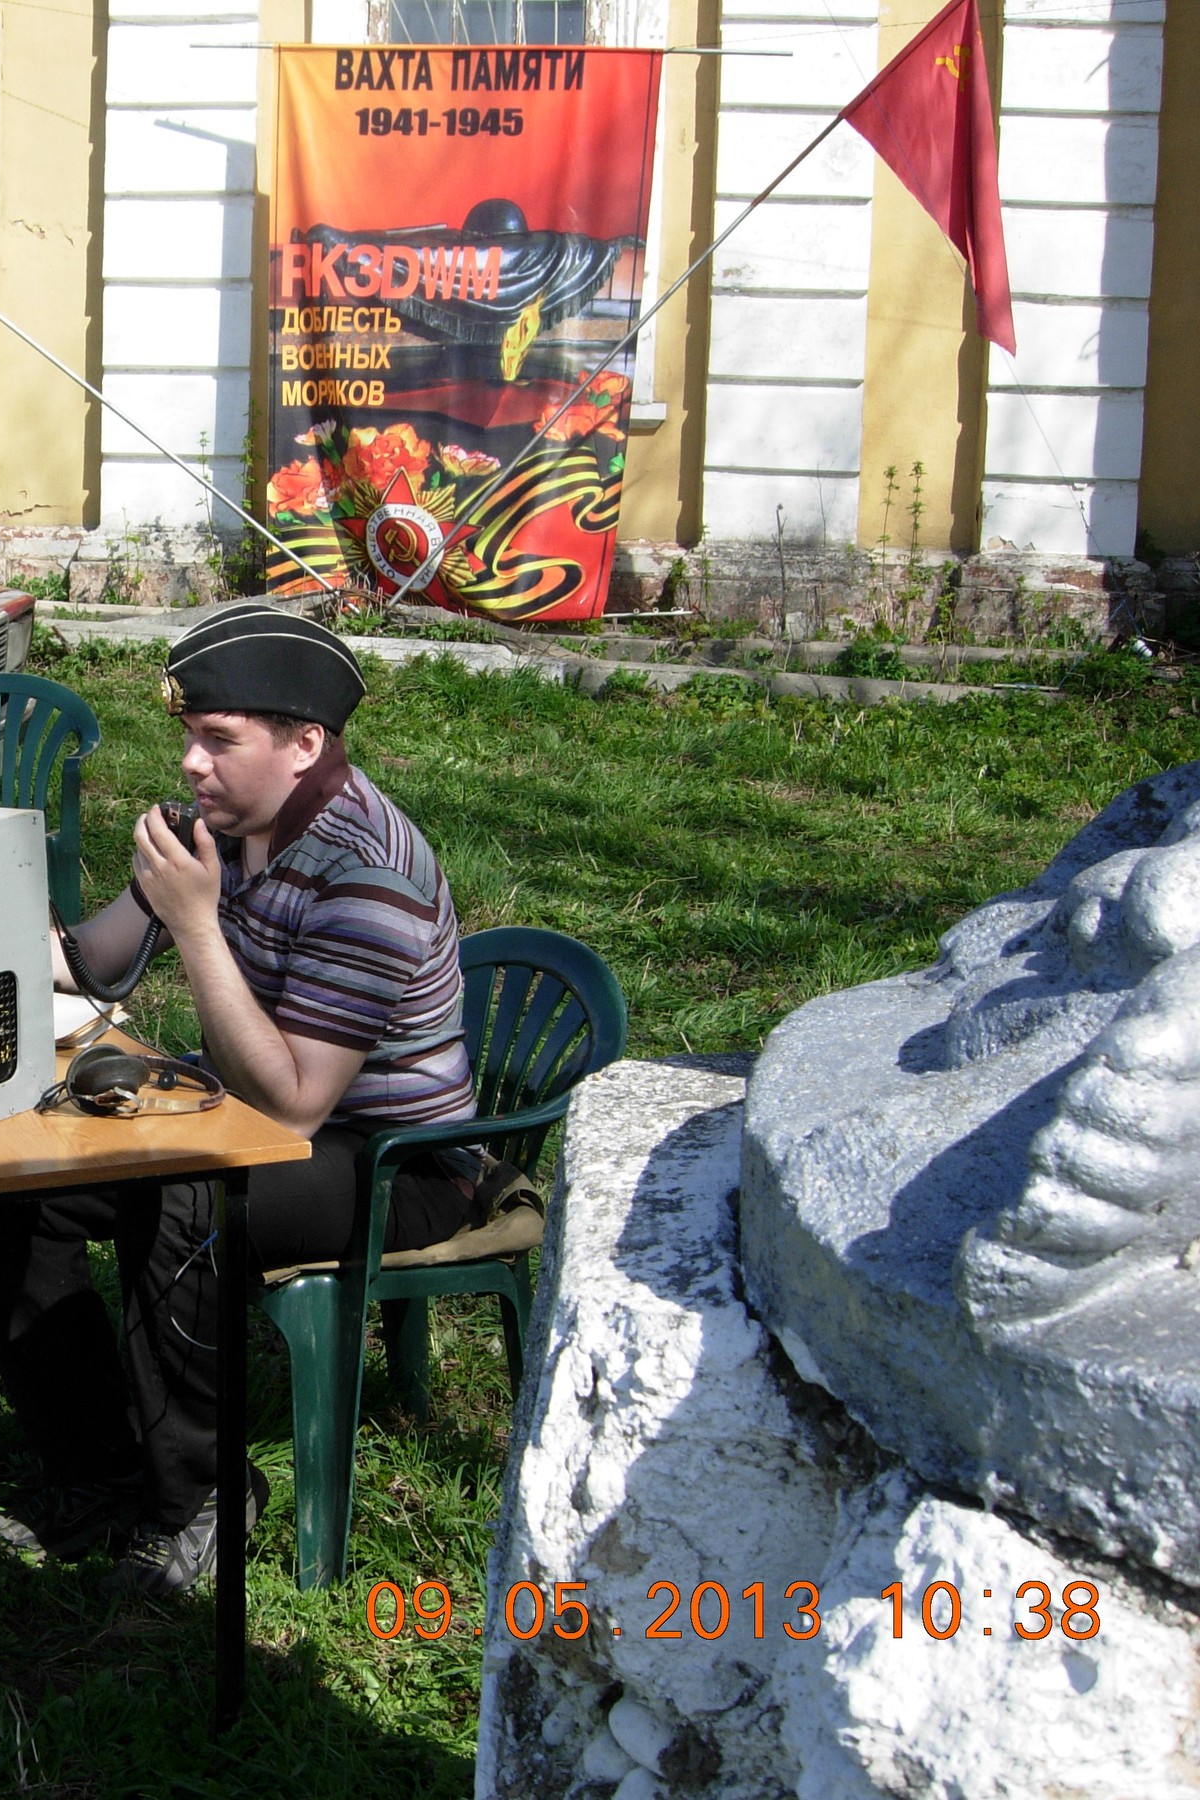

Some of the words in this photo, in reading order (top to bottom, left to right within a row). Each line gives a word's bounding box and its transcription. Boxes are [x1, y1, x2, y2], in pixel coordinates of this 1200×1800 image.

[334, 49, 434, 91] ВАХТА
[450, 49, 586, 91] ПАМЯТИ
[354, 107, 524, 137] 1941-1945
[281, 306, 402, 336] ДОБЛЕСТЬ
[281, 343, 391, 371] ВОЕННЫХ
[281, 380, 386, 407] МОРЯКОВ
